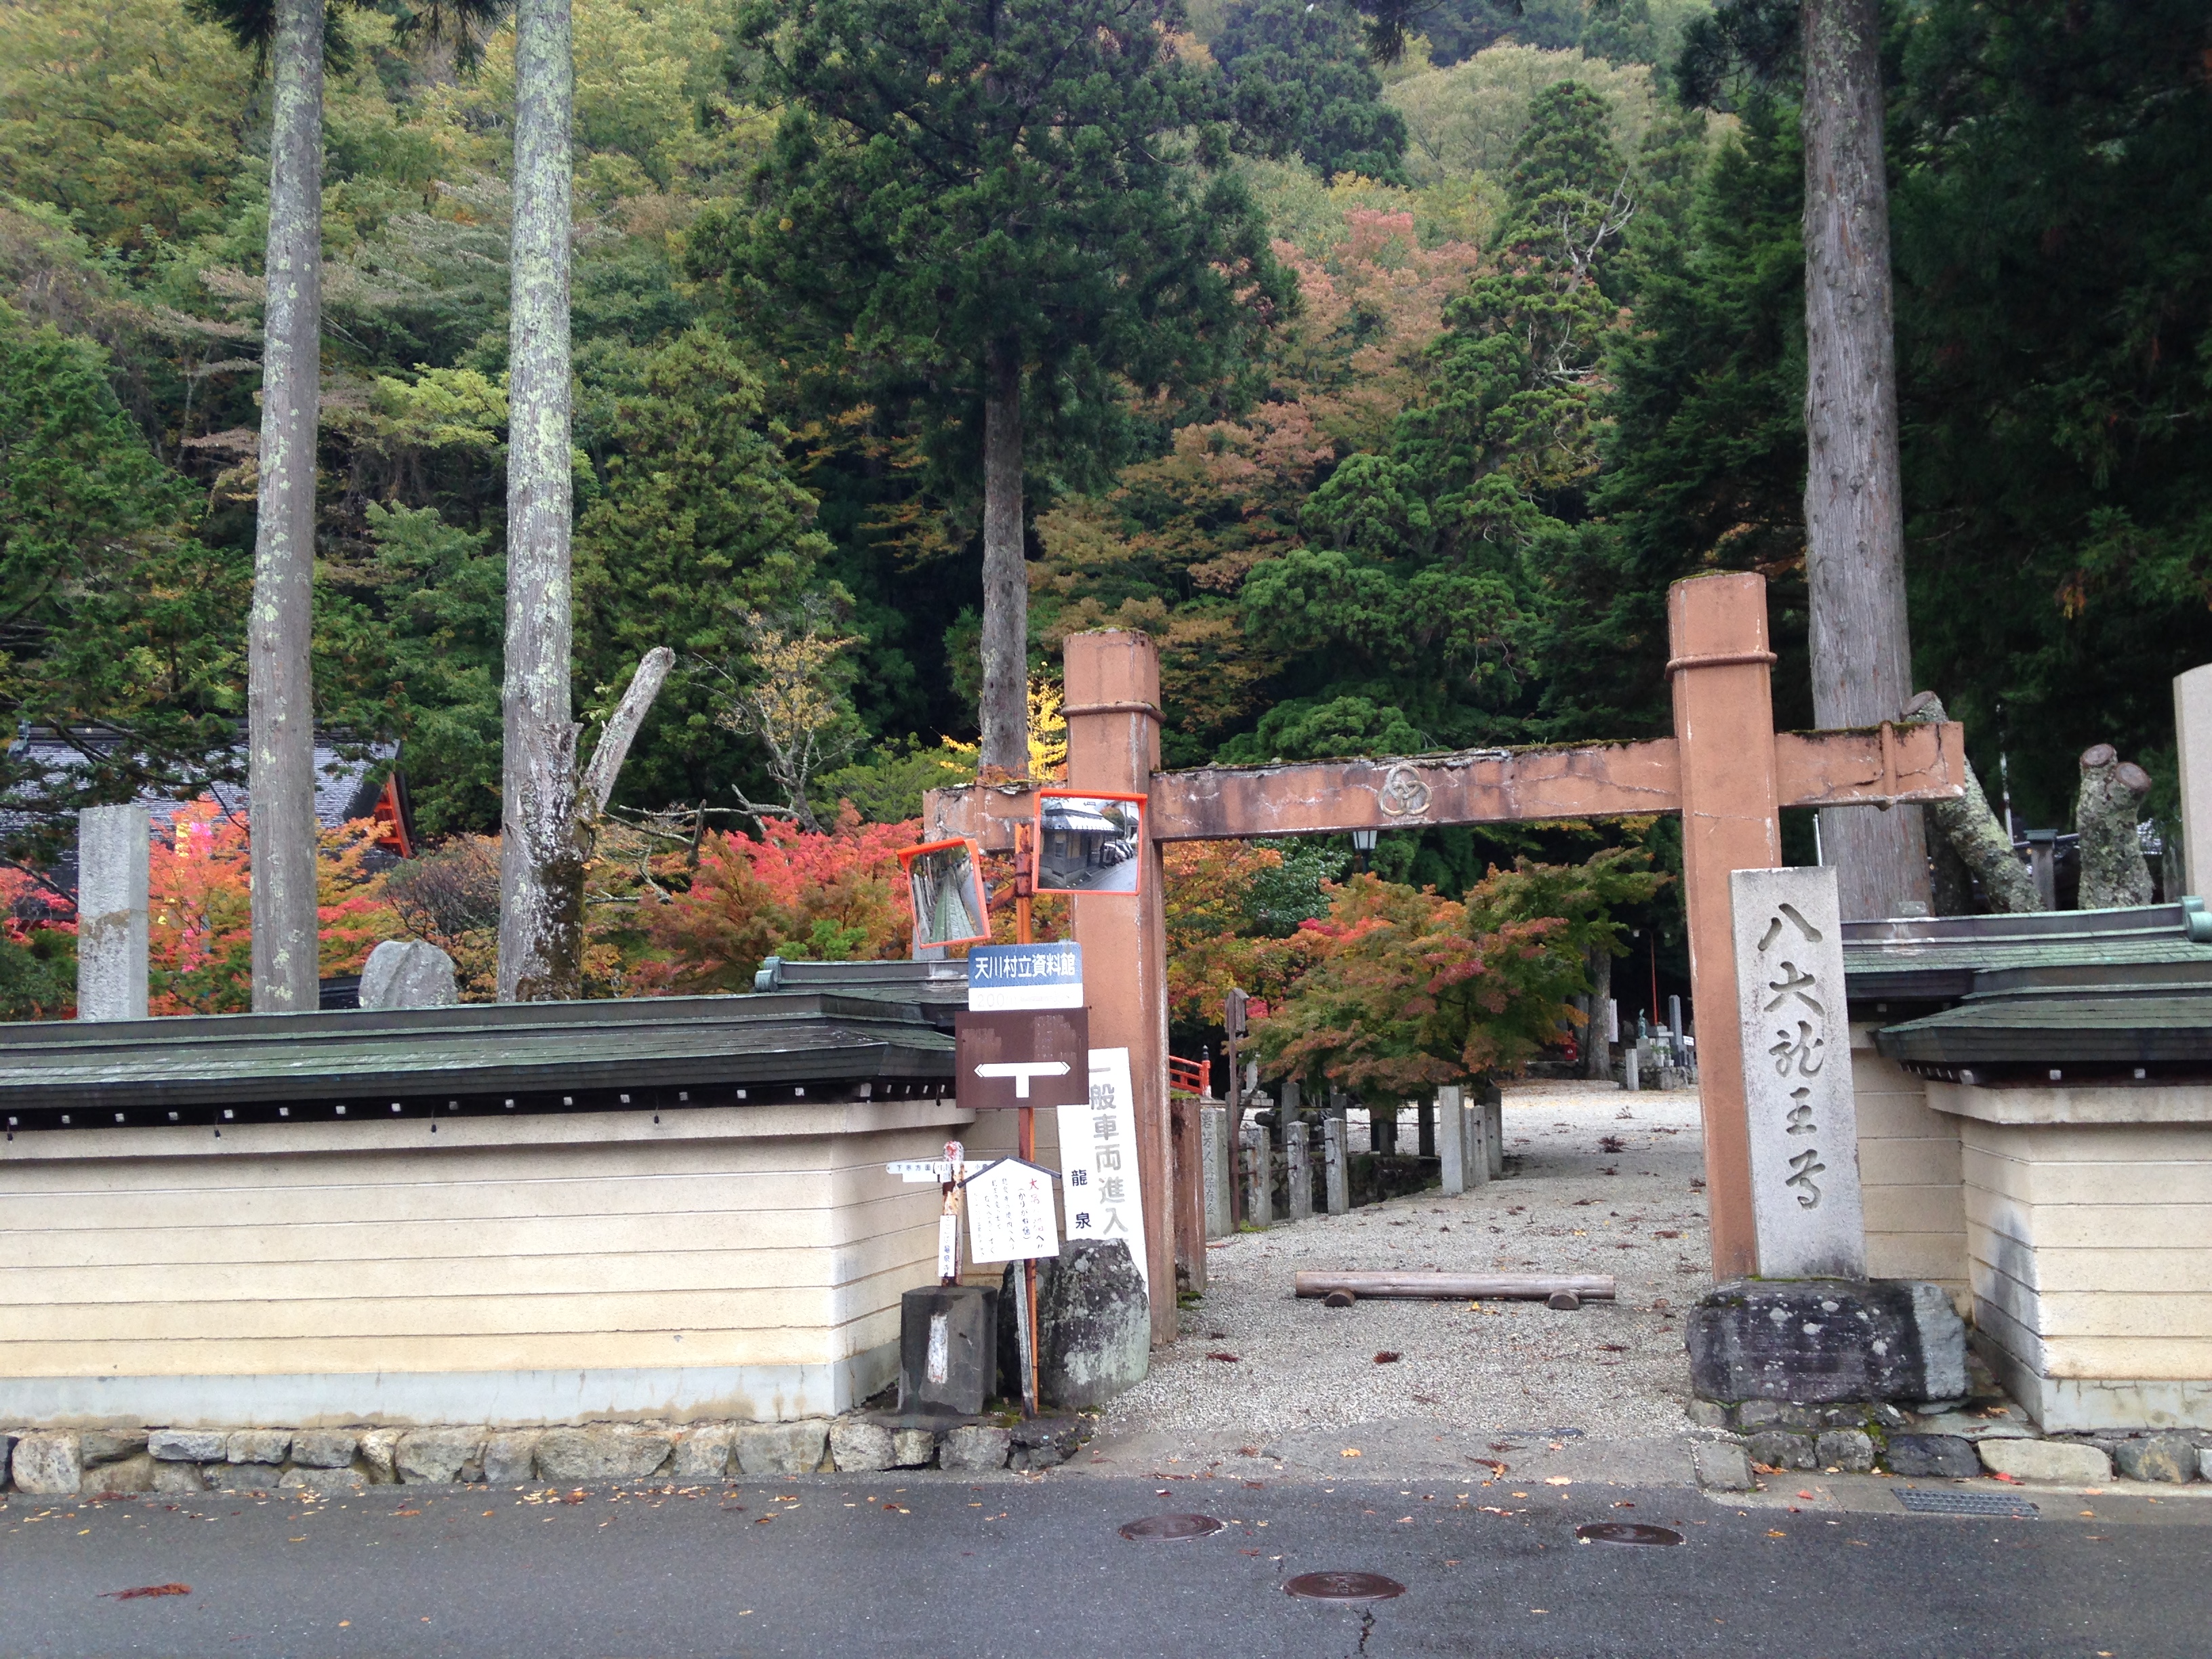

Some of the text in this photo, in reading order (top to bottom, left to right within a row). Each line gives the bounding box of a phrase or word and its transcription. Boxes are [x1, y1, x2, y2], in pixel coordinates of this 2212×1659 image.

[975, 951, 1076, 980] 天川村立資料館
[1088, 1067, 1130, 1246] 一般車両進入
